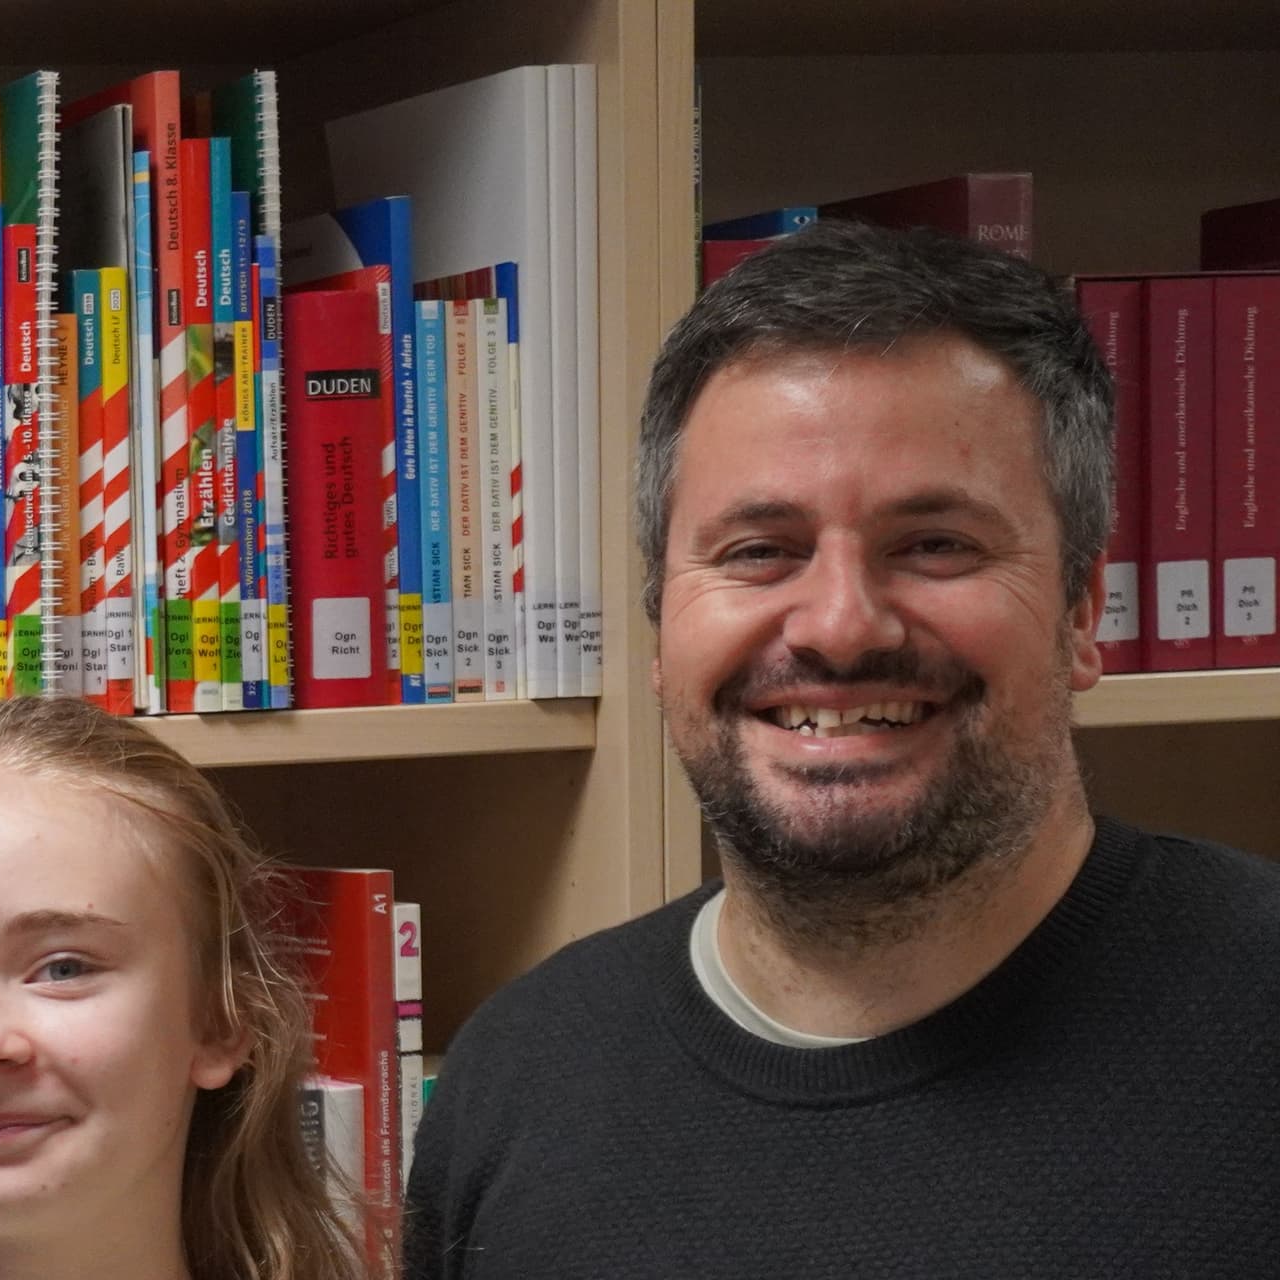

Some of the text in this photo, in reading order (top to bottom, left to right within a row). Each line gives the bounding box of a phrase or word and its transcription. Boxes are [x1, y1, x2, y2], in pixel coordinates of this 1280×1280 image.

[166, 122, 180, 251] Deutsch Klasse
[196, 249, 208, 308] Deutsch
[219, 248, 232, 306] Deutsch
[19, 321, 32, 373] Deutsch
[83, 317, 94, 366] Deutsch
[266, 302, 276, 340] DUDEN
[308, 378, 371, 396] DUDEN
[458, 341, 467, 436] GENITIV FOLGE
[1173, 308, 1190, 531] Englische amerikanische Dichtung
[1243, 306, 1258, 528] Englische amerikanische Dichtung
[199, 447, 215, 528] Erzählen
[222, 417, 235, 527] Gedichtanalyse
[324, 442, 337, 477] und
[332, 645, 360, 656] Richt
[398, 920, 420, 957] 2
[379, 1050, 391, 1135] Fremdsprache
